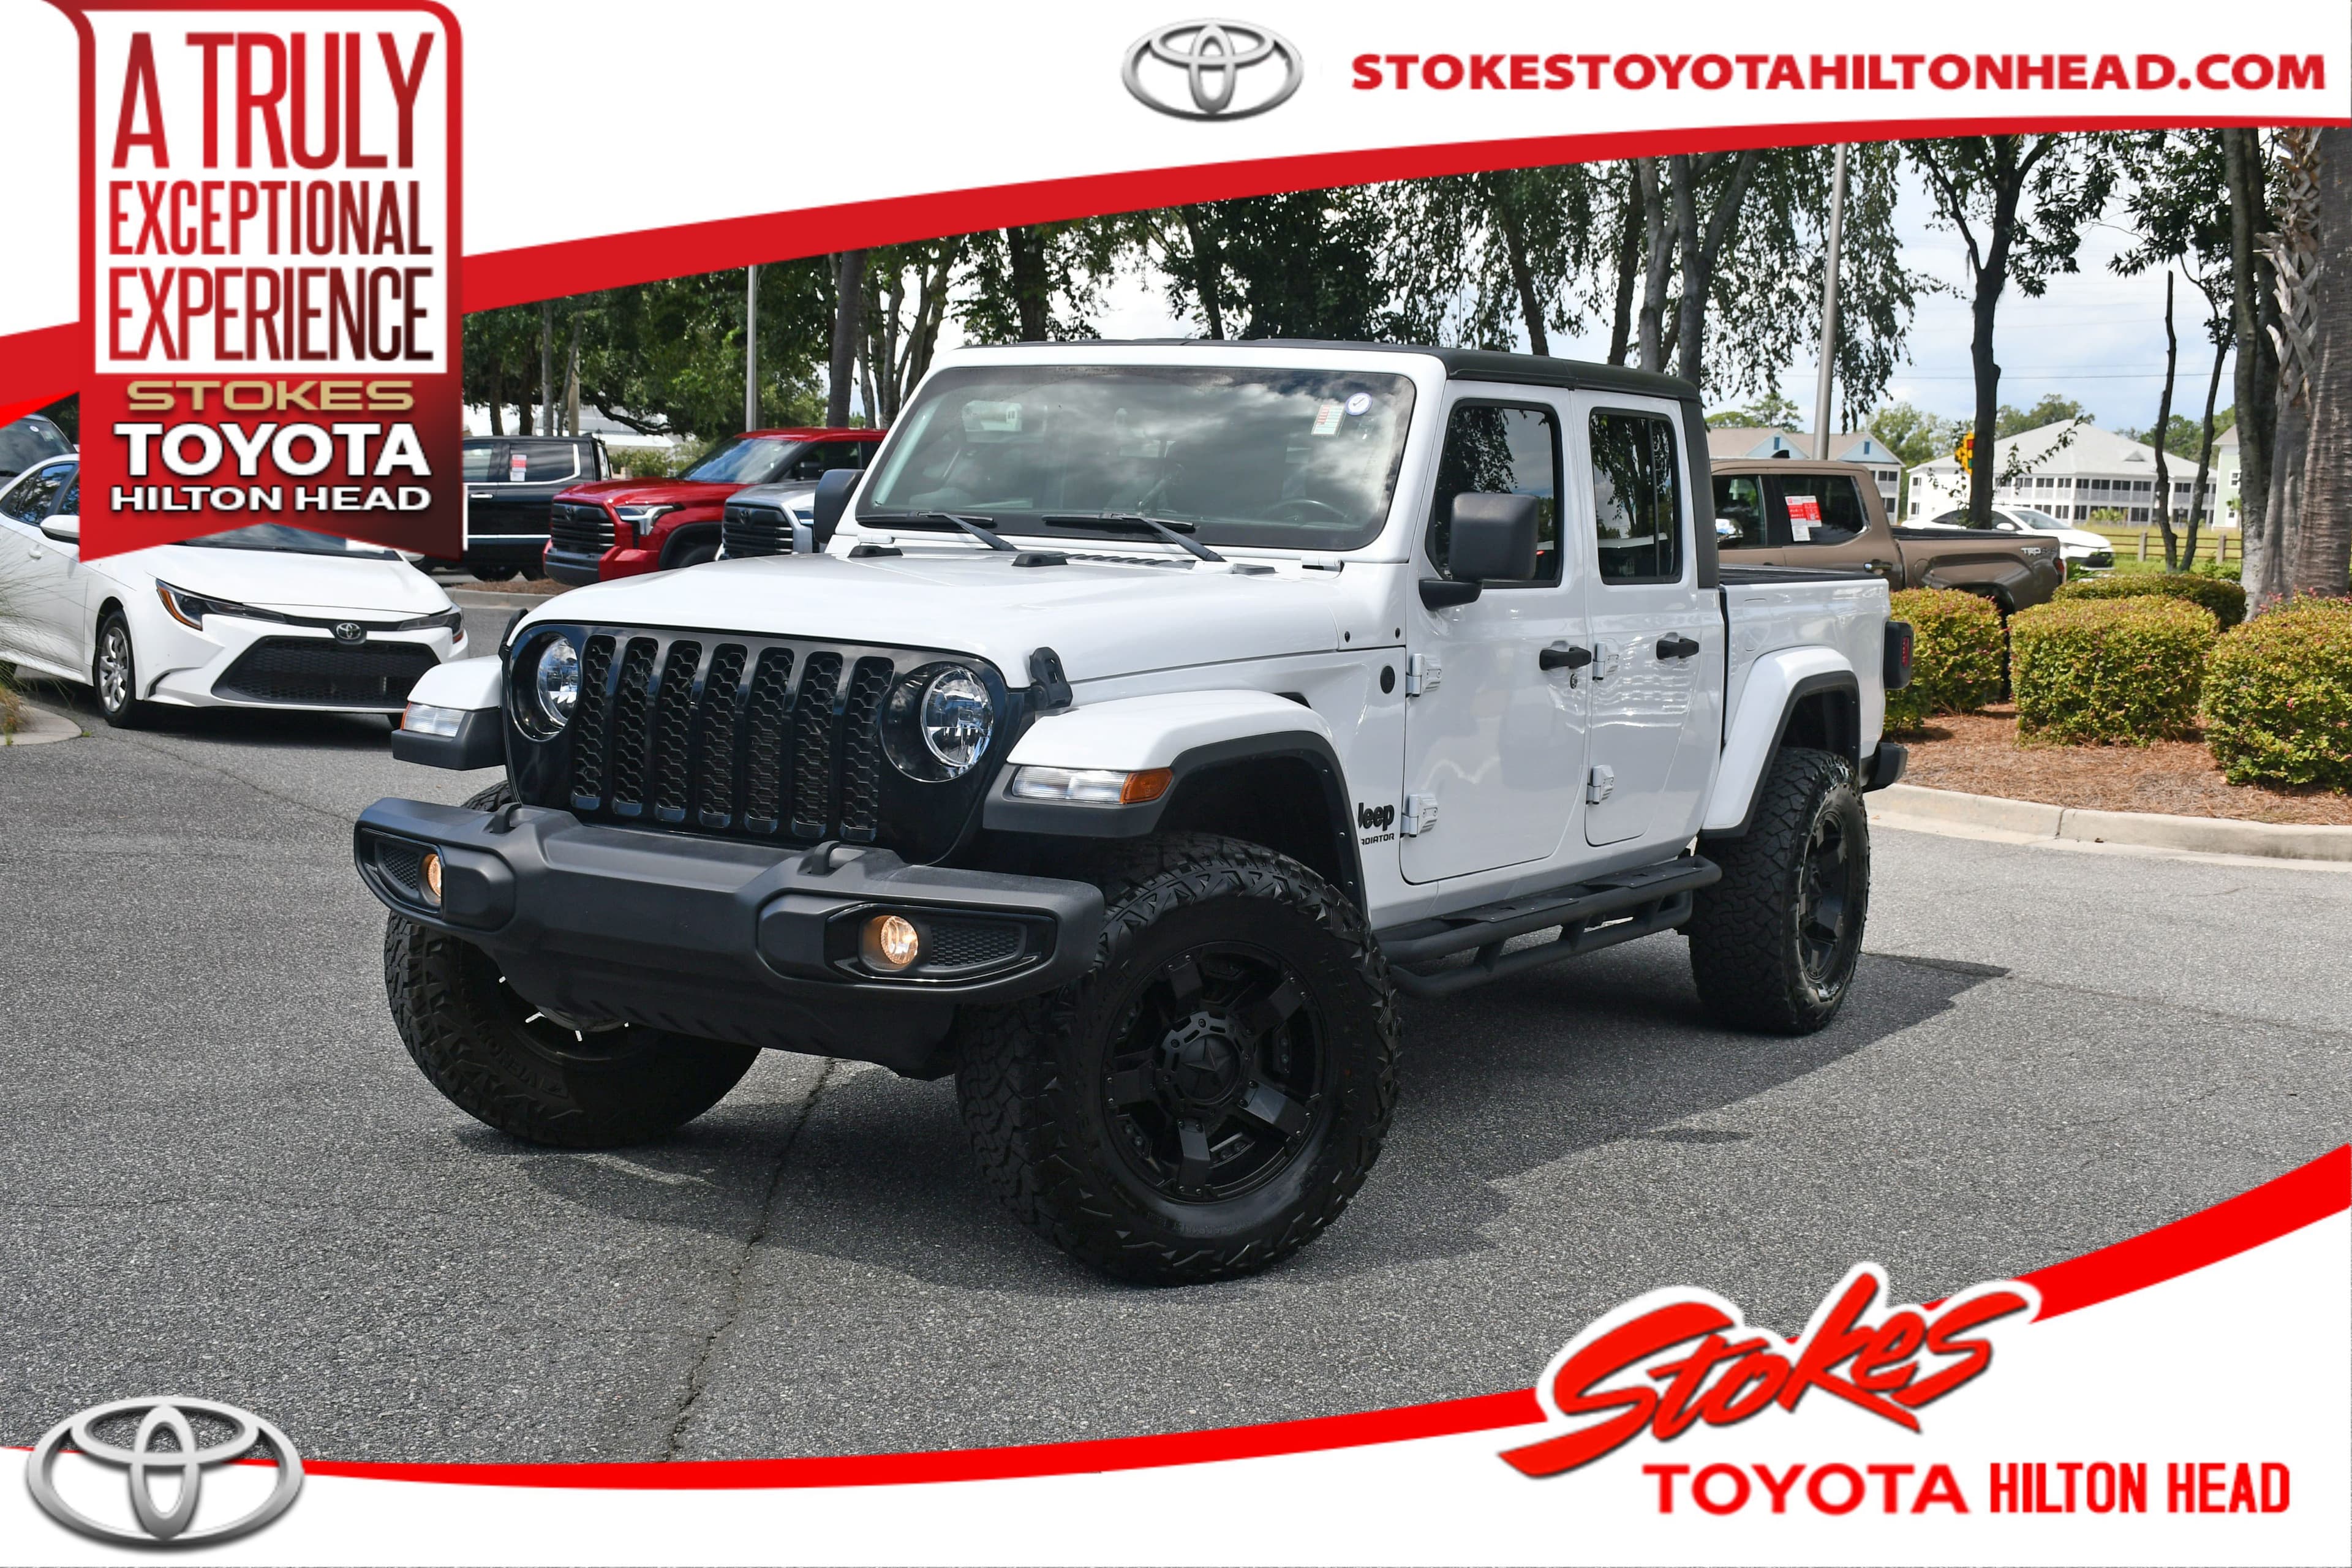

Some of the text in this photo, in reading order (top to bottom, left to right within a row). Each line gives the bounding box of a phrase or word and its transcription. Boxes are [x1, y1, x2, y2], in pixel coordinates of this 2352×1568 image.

[2021, 547, 2041, 556] TRD
[1358, 802, 1395, 831] Jeep
[1361, 833, 1395, 845] ADIATOR
